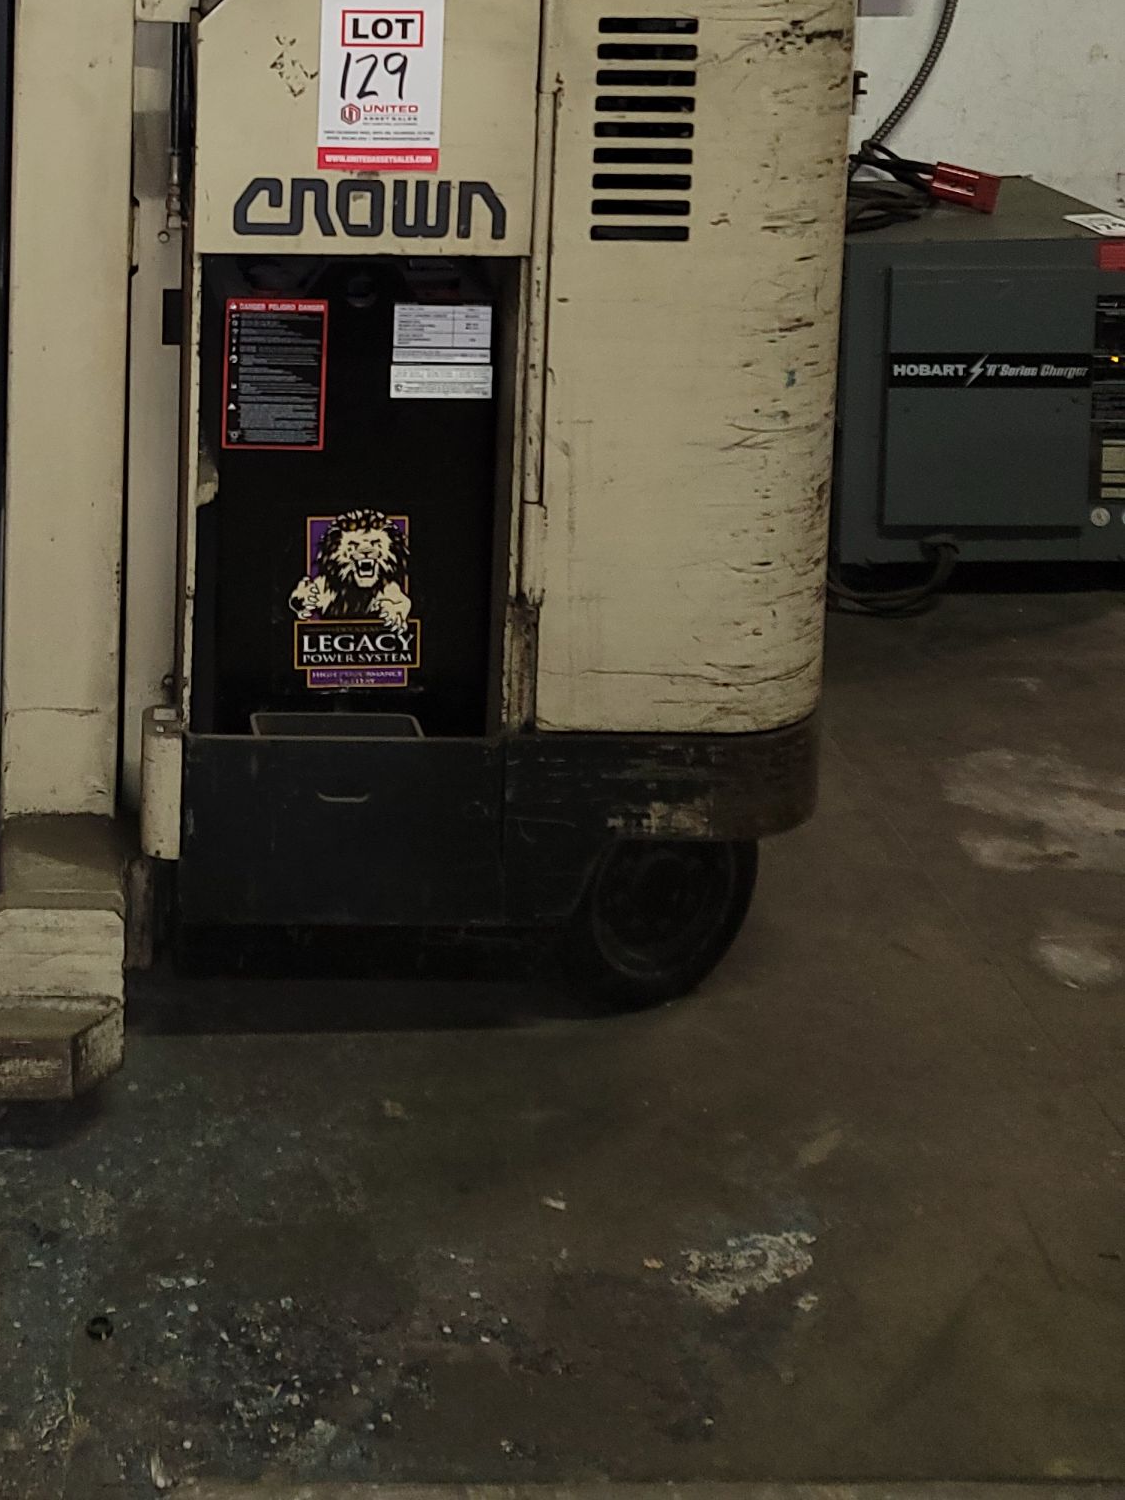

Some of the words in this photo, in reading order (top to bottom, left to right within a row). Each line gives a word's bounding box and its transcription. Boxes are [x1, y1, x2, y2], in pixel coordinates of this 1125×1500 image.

[352, 18, 415, 40] LOT
[340, 52, 408, 100] 129
[363, 105, 419, 113] UNITED
[233, 177, 507, 240] CROWN
[893, 364, 968, 377] HOBART
[999, 364, 1039, 377] Series
[303, 633, 414, 652] LEGACY
[303, 653, 355, 663] POWER
[358, 653, 412, 662] SYSTEM
